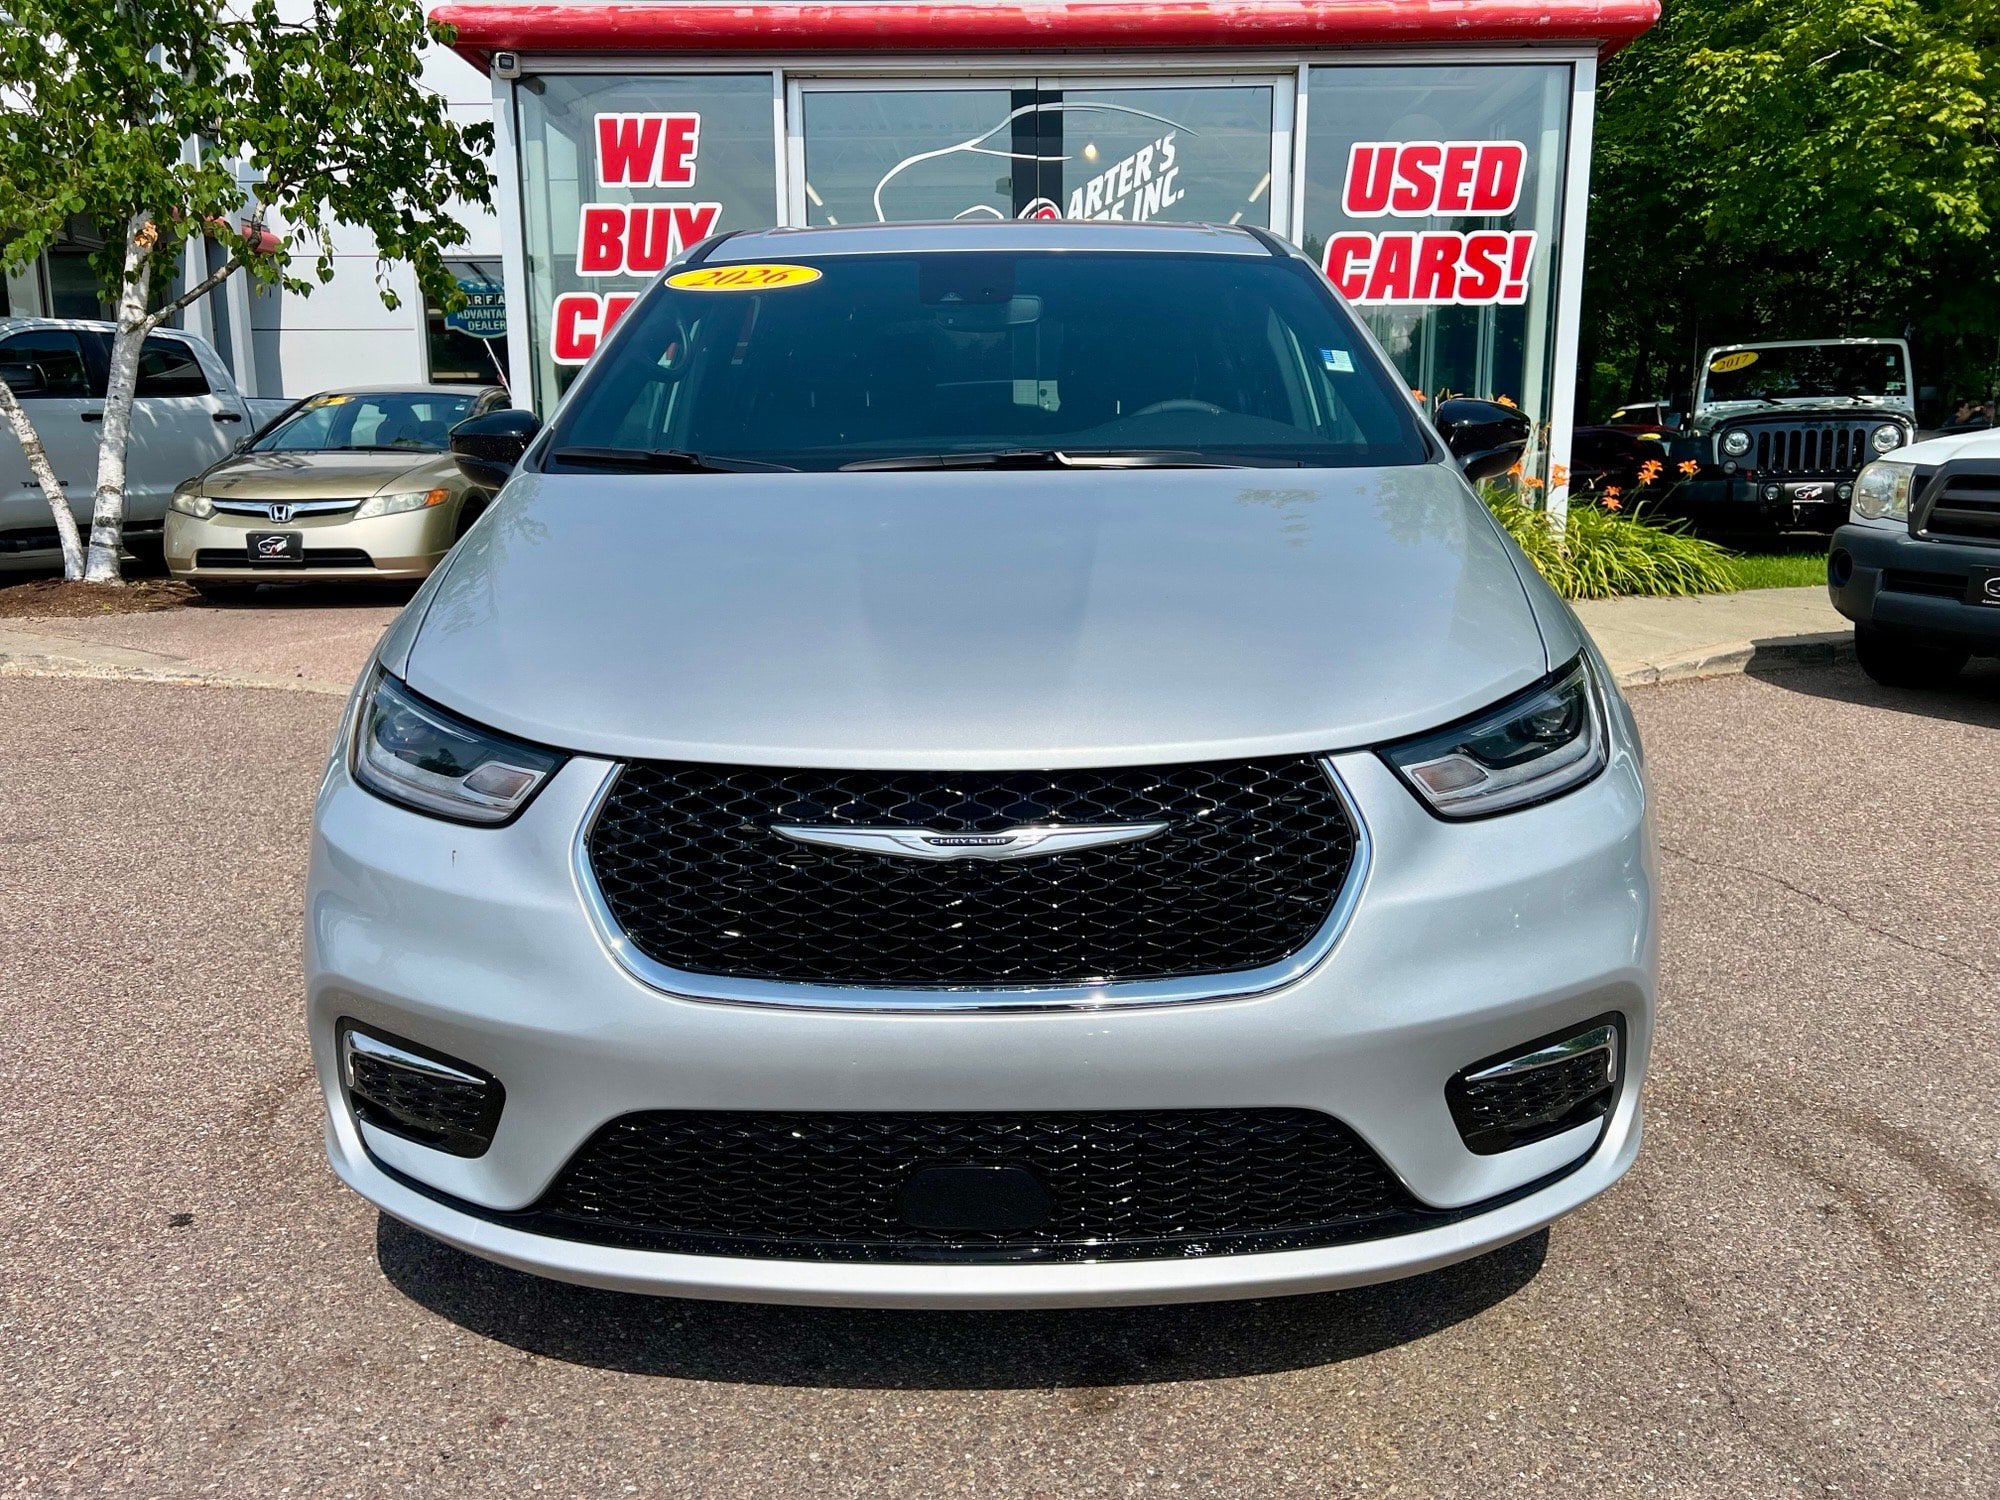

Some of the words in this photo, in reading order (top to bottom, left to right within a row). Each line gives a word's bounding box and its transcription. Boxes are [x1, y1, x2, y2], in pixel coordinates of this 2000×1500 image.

[597, 115, 698, 184] WE
[1131, 166, 1185, 222] INC.
[1345, 144, 1524, 214] USED
[580, 205, 718, 273] BUY
[1326, 233, 1534, 301] CARS!
[687, 268, 796, 287] 2026
[467, 320, 507, 331] DEALER
[1718, 353, 1750, 371] 2017
[929, 837, 1007, 846] CHRYSLER
